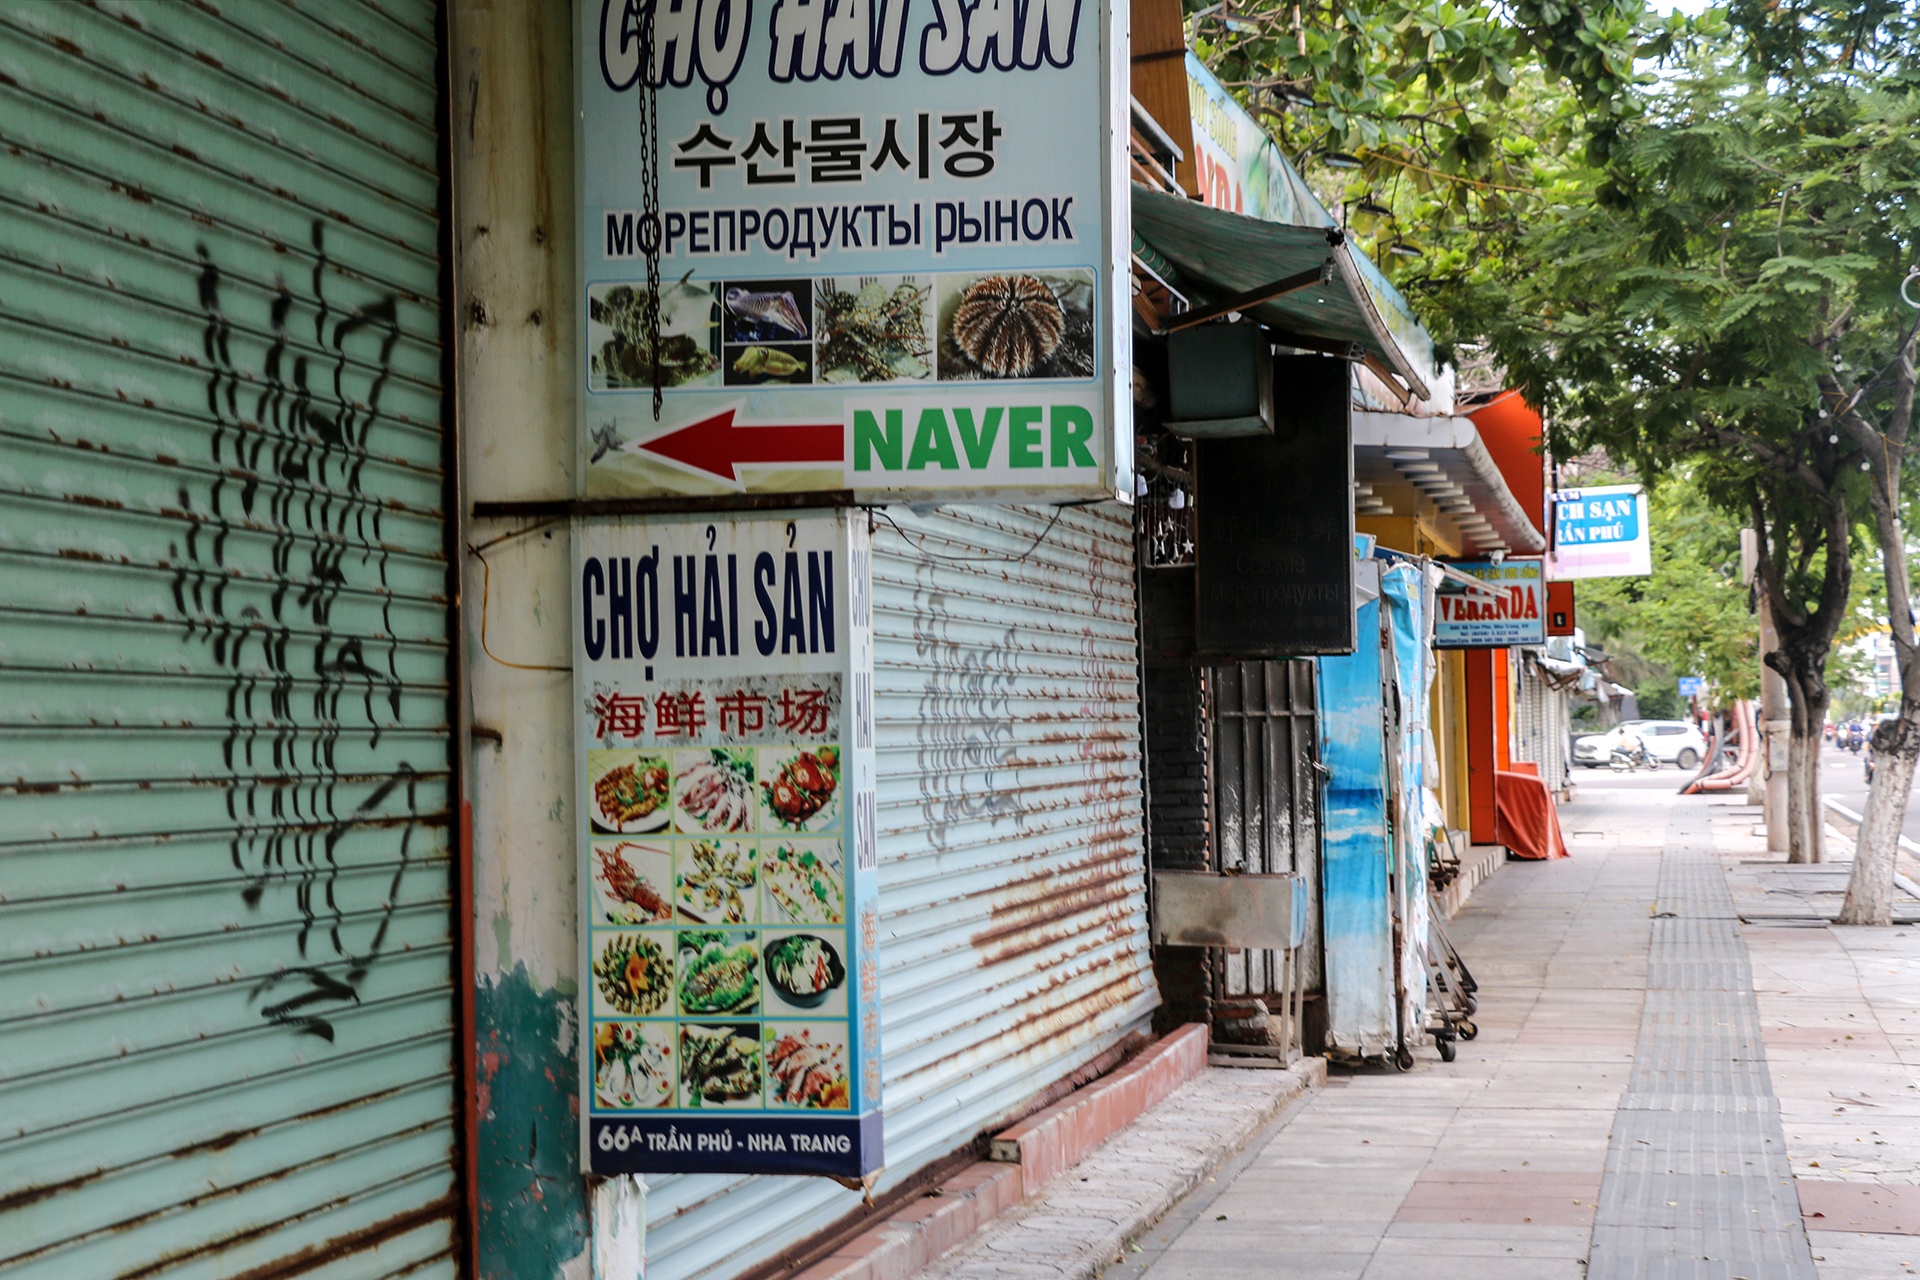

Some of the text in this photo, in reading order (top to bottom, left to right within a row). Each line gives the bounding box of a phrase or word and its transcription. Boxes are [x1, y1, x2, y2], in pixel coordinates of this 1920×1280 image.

[674, 110, 1002, 188] 수산물시장
[607, 203, 920, 258] МОРЕПРОДУКТЫ
[854, 405, 1097, 471] NAVER
[1559, 500, 1631, 522] CH SẠN
[1589, 520, 1624, 541] PHÚ
[582, 522, 835, 681] CHỢ HẢI SẢN
[595, 689, 829, 739] 海鲜市场
[598, 1124, 643, 1152] 66A
[647, 1124, 692, 1152] TRẦN
[697, 1128, 732, 1152] PHÚ
[748, 1134, 786, 1152] NHA
[790, 1134, 851, 1153] TRANG
